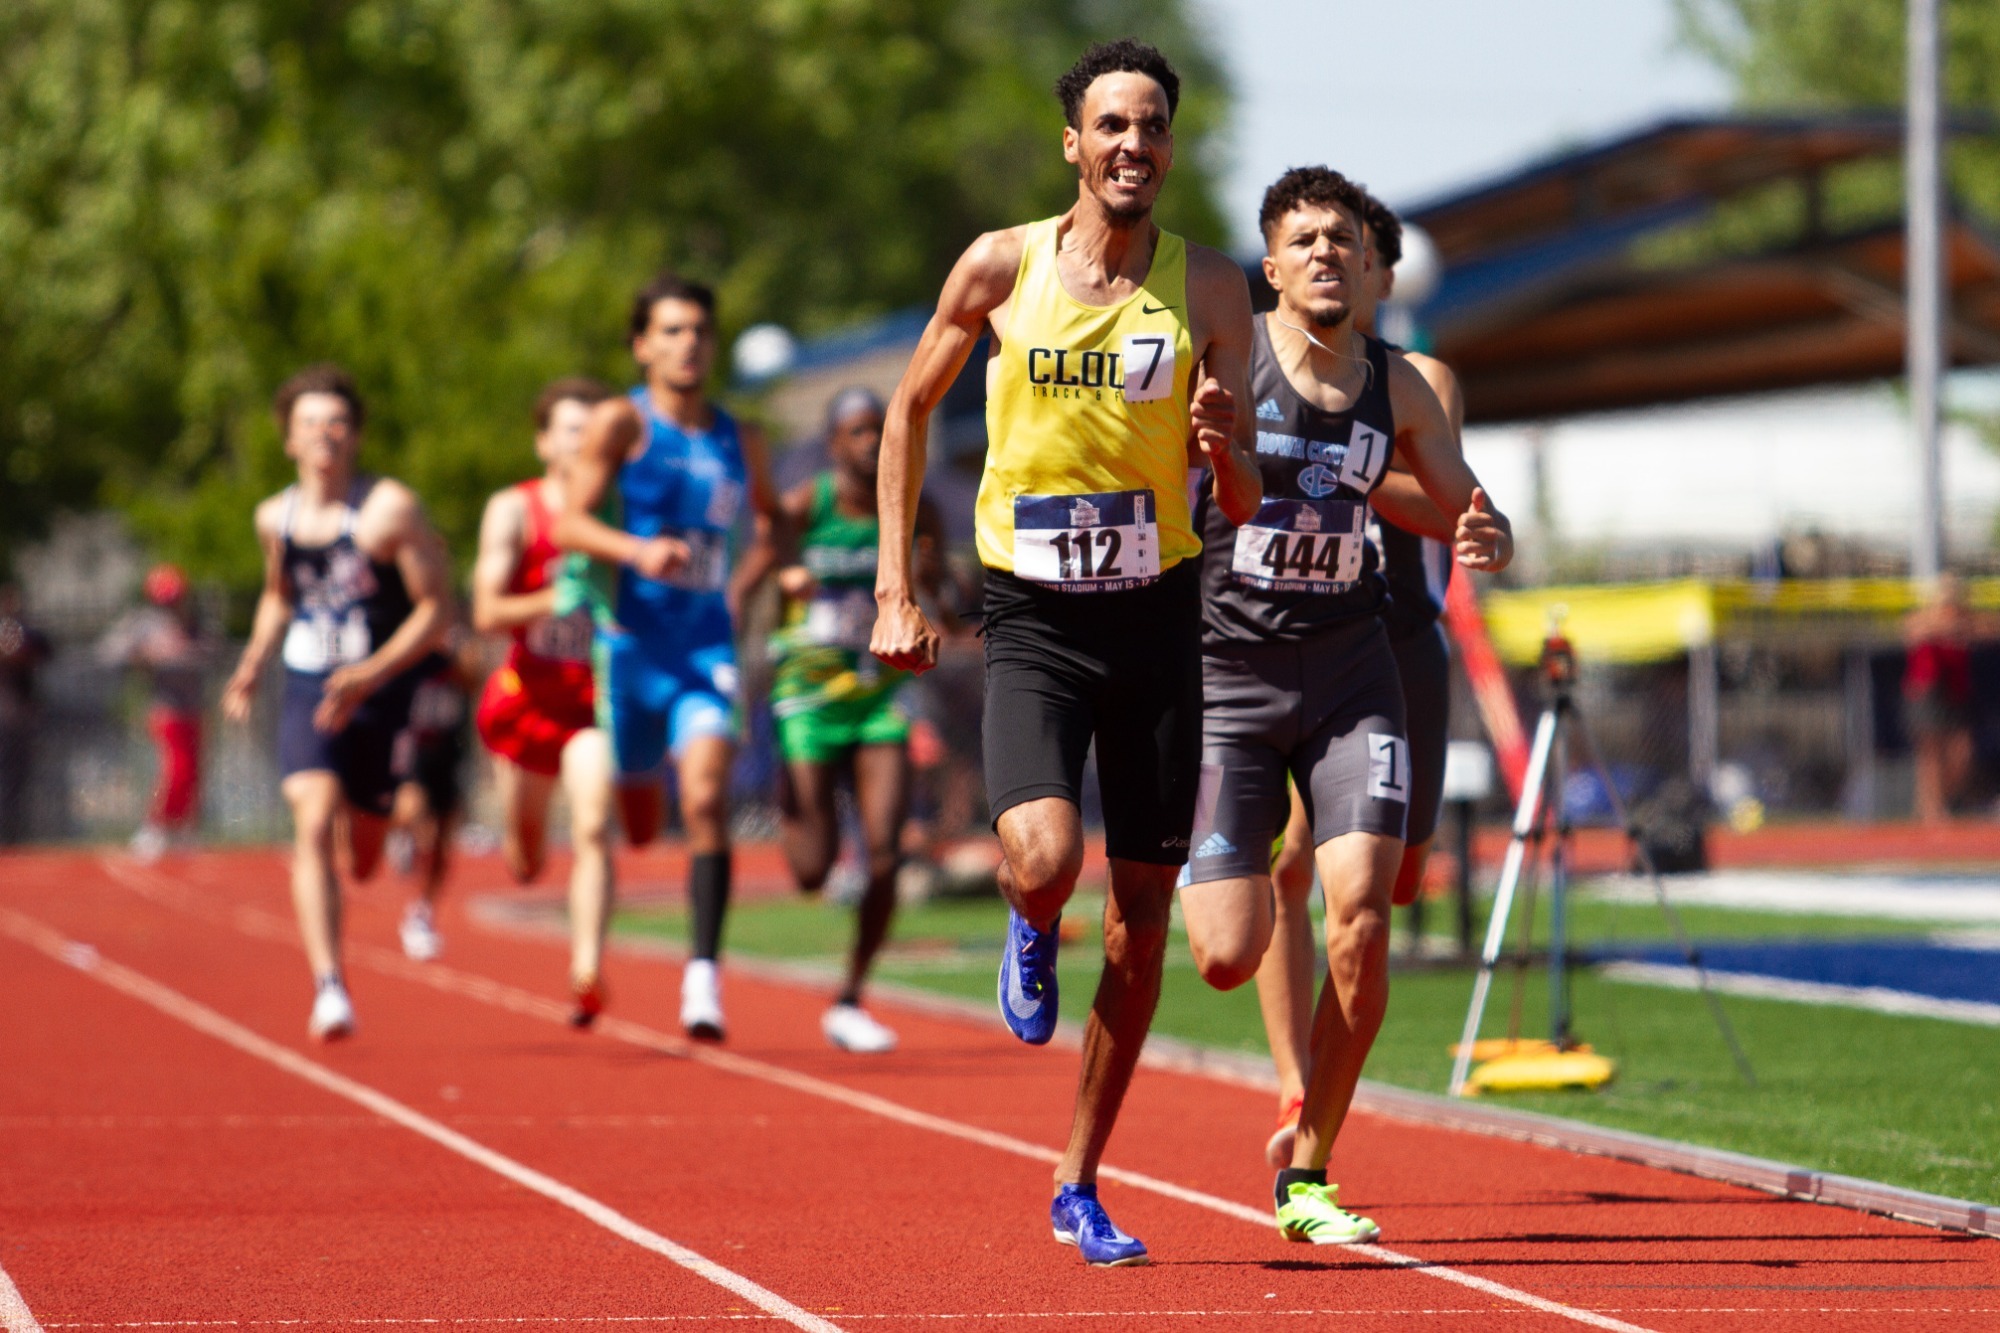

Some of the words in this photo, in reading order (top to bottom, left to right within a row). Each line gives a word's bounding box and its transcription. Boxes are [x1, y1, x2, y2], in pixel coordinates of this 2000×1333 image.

[1029, 348, 1125, 389] CLOU
[1132, 338, 1165, 391] 7
[1032, 386, 1080, 399] TRACK
[1256, 431, 1306, 459] IOWA
[1352, 432, 1374, 483] 1
[1049, 529, 1122, 579] 112
[1261, 533, 1341, 579] 444
[1061, 583, 1097, 592] STADIUM
[1105, 581, 1123, 591] MAY
[1125, 579, 1134, 589] 15
[1141, 578, 1150, 587] 17
[1274, 581, 1306, 591] STADIUM
[1313, 582, 1330, 594] MAY
[1379, 740, 1403, 791] 1
